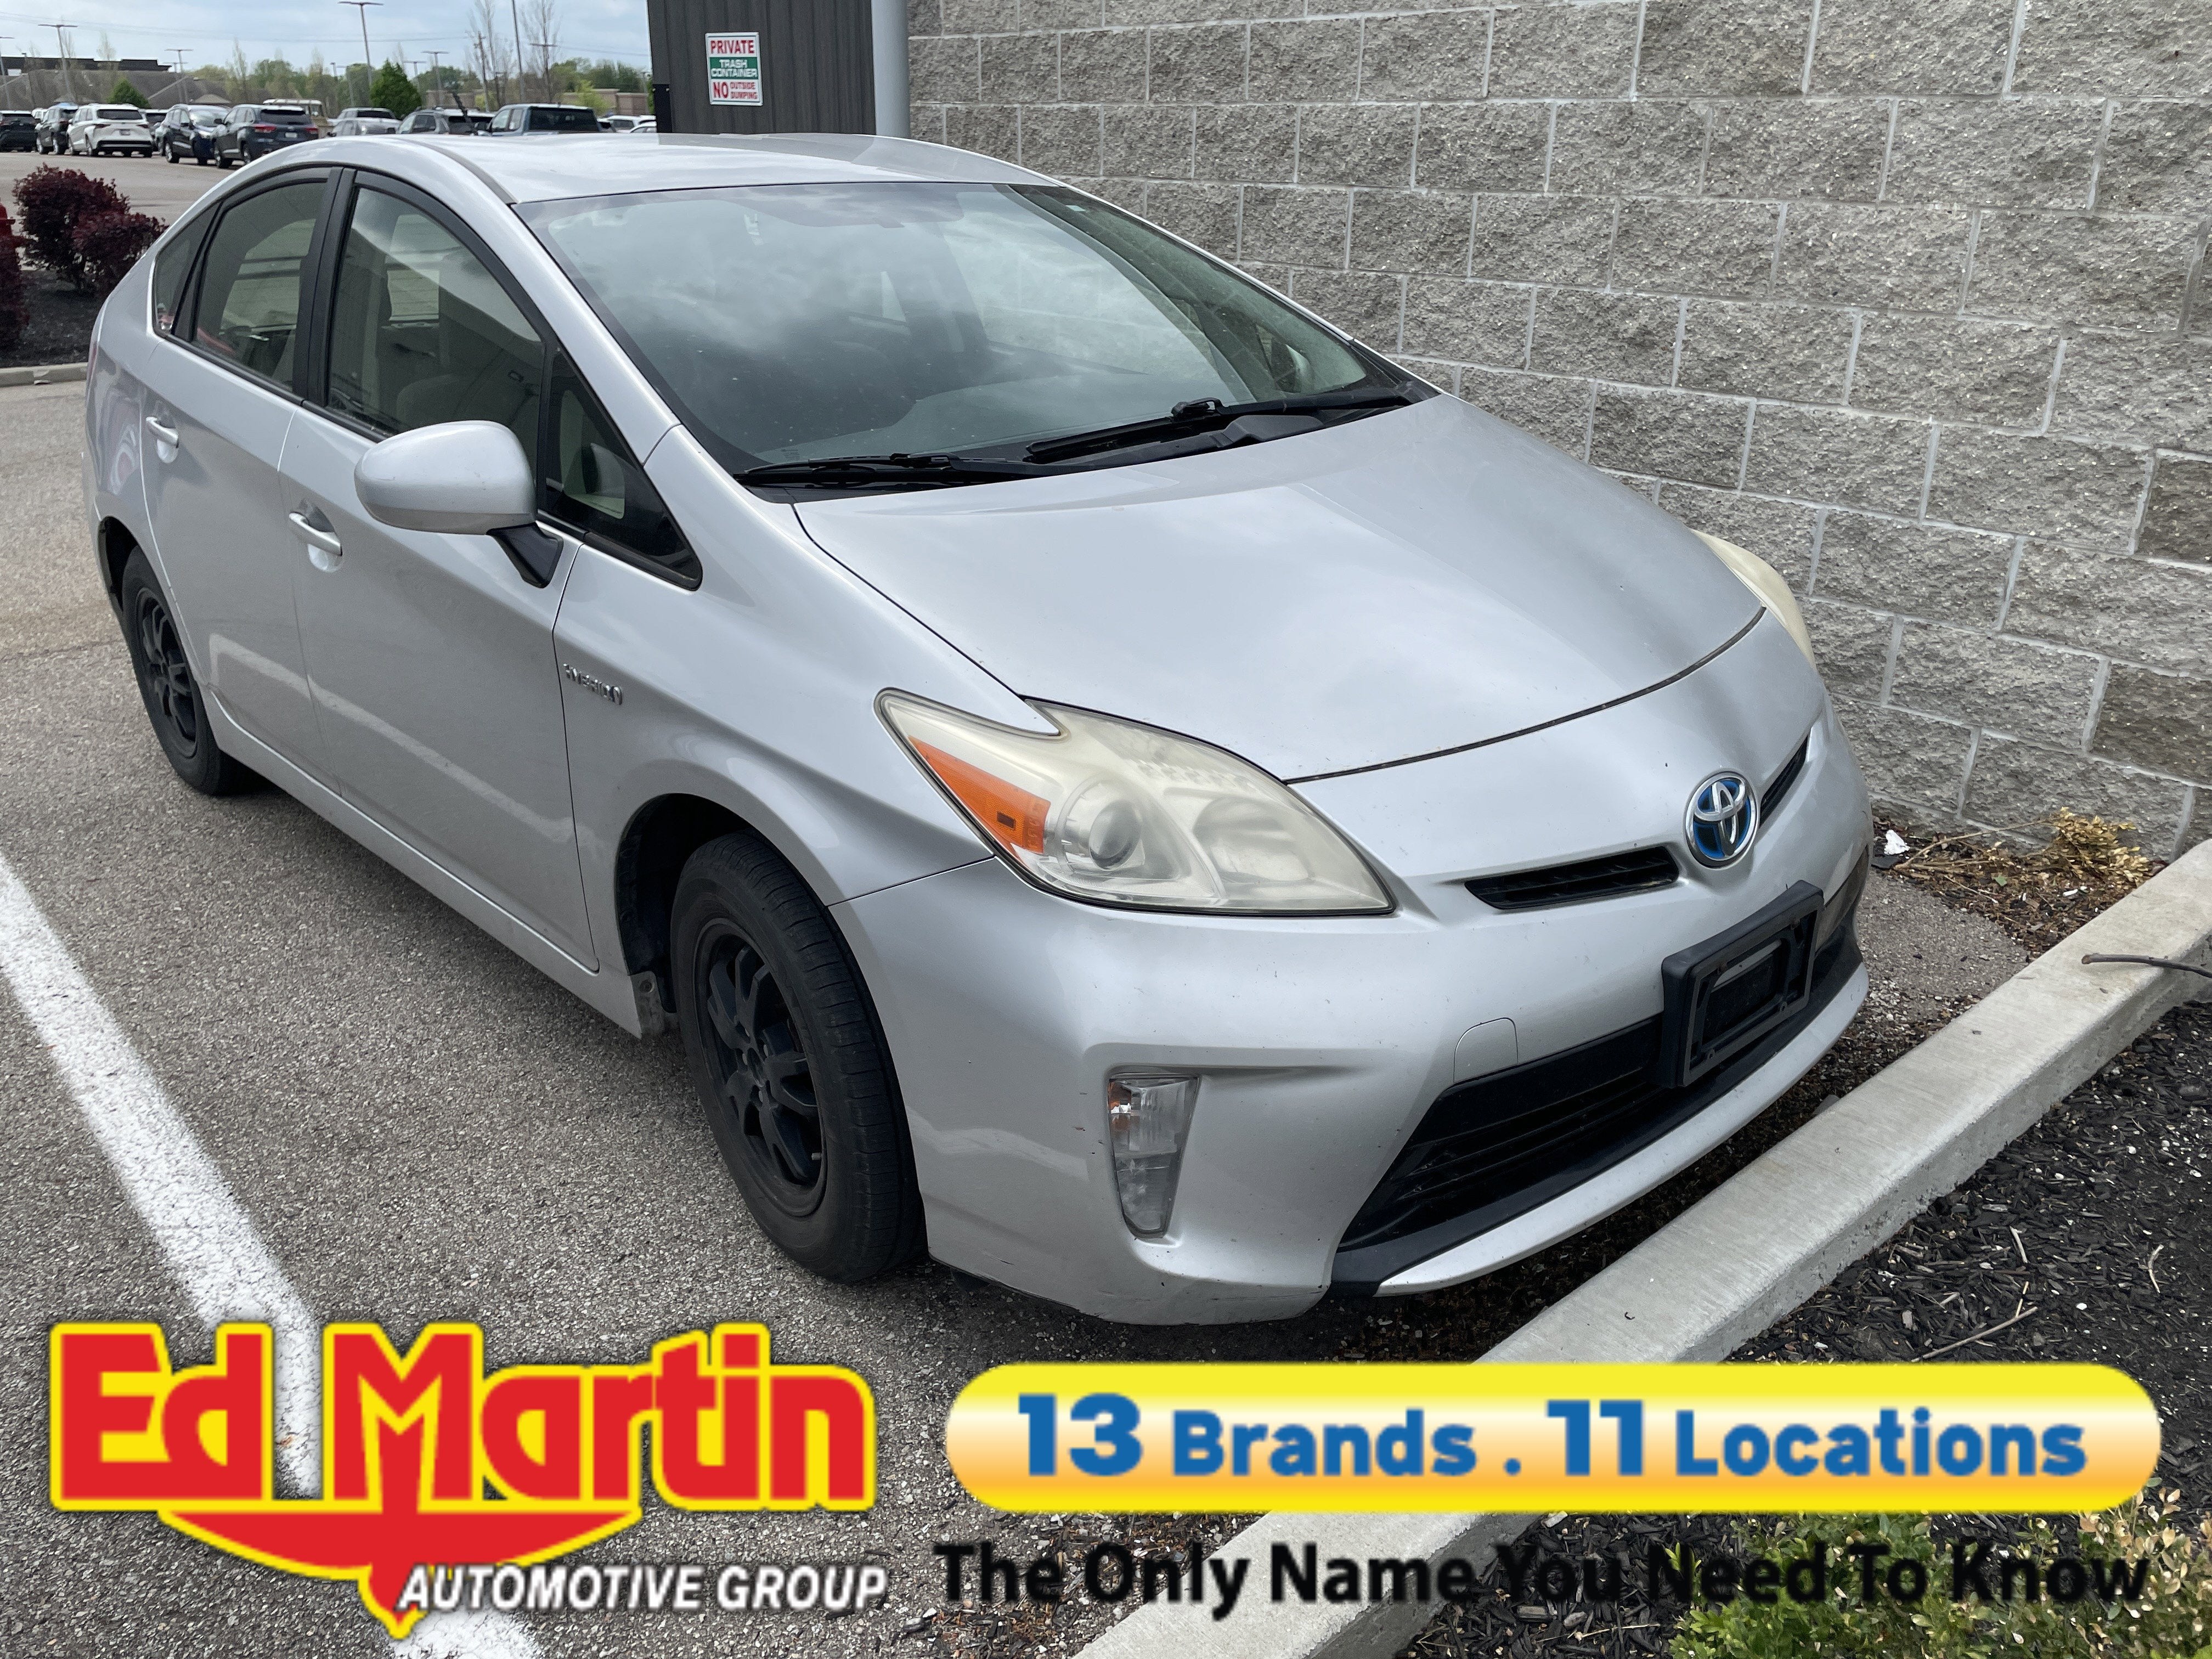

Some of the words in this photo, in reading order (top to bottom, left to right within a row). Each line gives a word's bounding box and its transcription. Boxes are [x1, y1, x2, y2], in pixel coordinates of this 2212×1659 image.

[710, 40, 754, 54] PRIVATE
[719, 59, 748, 69] TRASH
[710, 67, 758, 78] CONTAINER
[713, 81, 729, 99] NO
[730, 82, 755, 90] OUTSIDE
[730, 91, 758, 99] DUMPING
